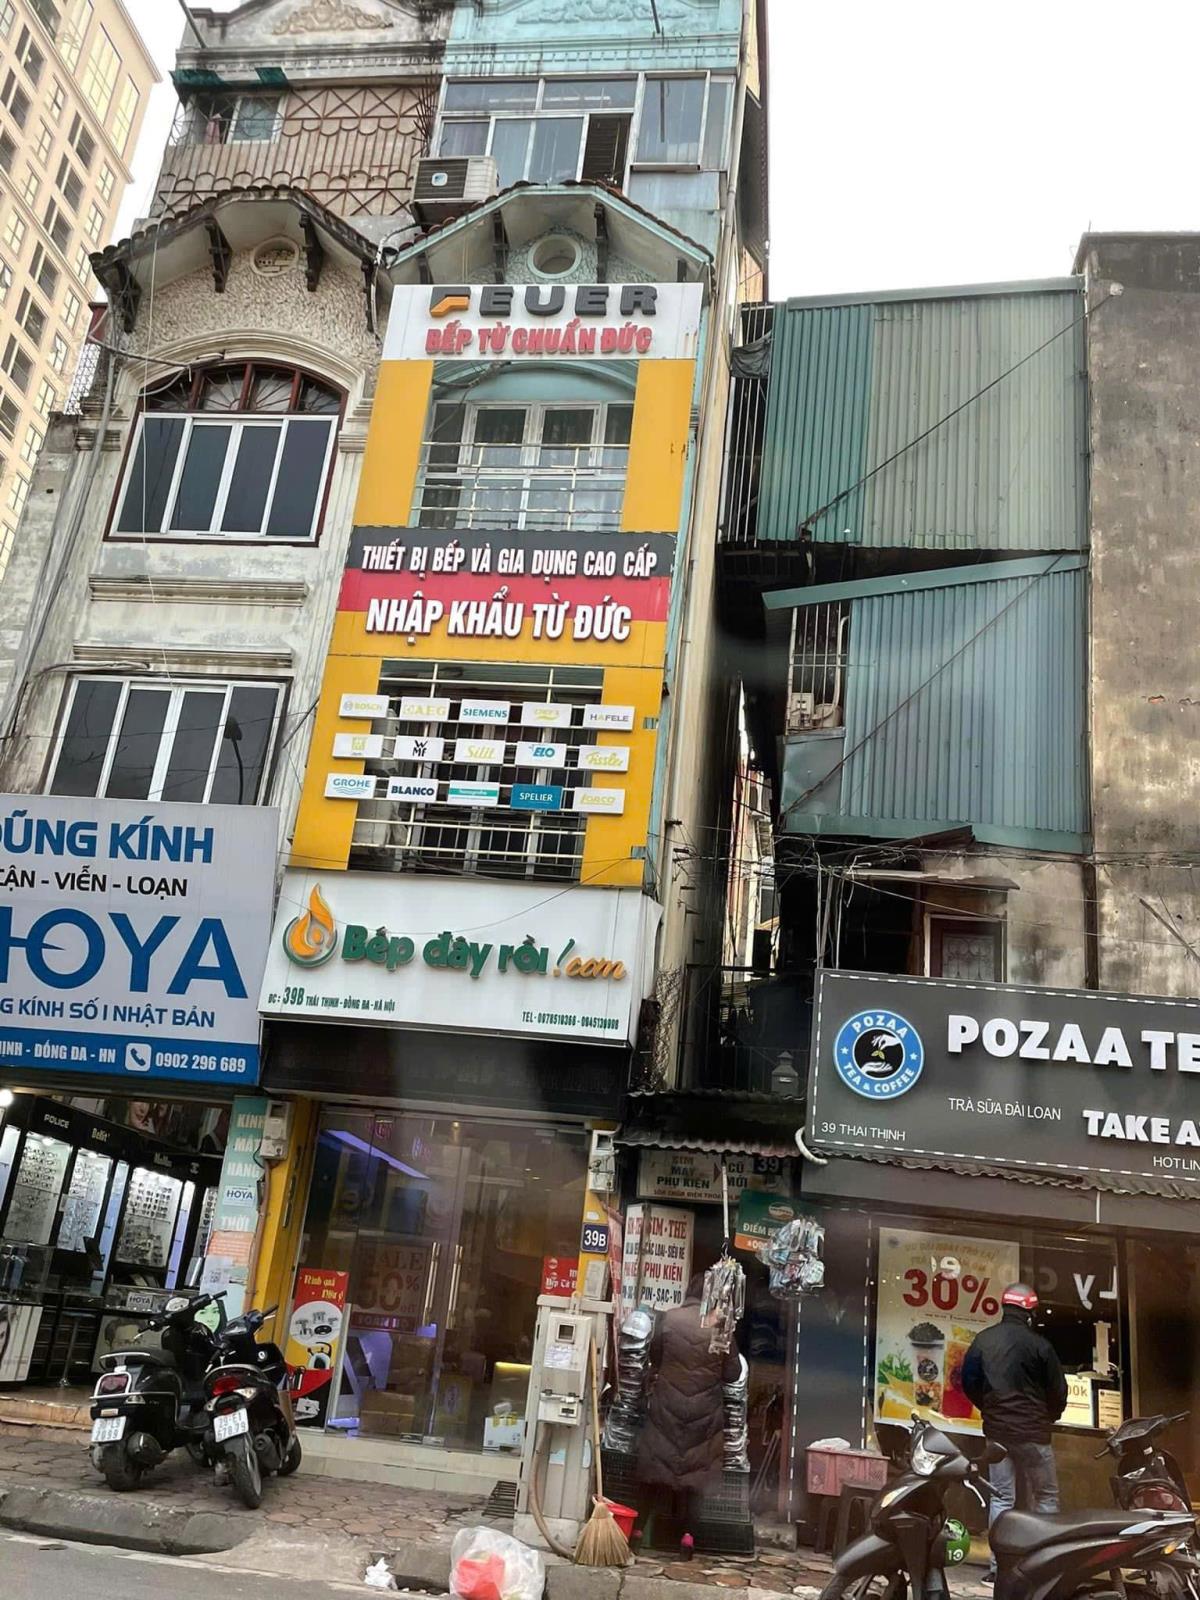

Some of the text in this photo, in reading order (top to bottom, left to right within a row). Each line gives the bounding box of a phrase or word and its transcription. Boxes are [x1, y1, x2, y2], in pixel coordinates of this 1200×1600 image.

[429, 286, 657, 318] FEUER
[425, 316, 653, 355] BẾP TỪ CHUẨN ĐỨC
[362, 537, 658, 584] THIẾT BỊ BẾP VÀ GIA DỤNG CAO CẤP
[366, 585, 632, 645] NHẬP KHẨU TỪ ĐỨC
[462, 707, 508, 719] SIEMENS
[333, 777, 371, 788] GROHE
[391, 785, 435, 797] BLANCO
[519, 791, 553, 802] SPELIER
[0, 810, 214, 864] ŨNG KÍNH
[54, 865, 107, 892] VIỄN
[127, 876, 188, 900] LOẠN
[341, 924, 415, 972] Bếp
[423, 931, 493, 979] đây
[283, 986, 305, 1006] 39B
[18, 995, 65, 1018] KÍNH
[70, 997, 99, 1020] SỐ
[113, 1003, 168, 1028] NHẬT
[172, 1006, 215, 1027] BẢN
[851, 1014, 908, 1039] POZAA
[0, 1040, 23, 1057] ỊNH
[99, 1048, 116, 1063] HN
[948, 1015, 1133, 1068] POZAA
[155, 1052, 246, 1073] 0902 296 689
[843, 1061, 862, 1086] TEA
[874, 1067, 916, 1093] COFFEE
[44, 1113, 70, 1129] POLICE
[949, 1097, 1061, 1121] TRÀ SỮA ĐÀI LOAN
[821, 1121, 906, 1144] 39 THAI THỊNH
[1082, 1110, 1170, 1145] TAKE
[758, 1157, 780, 1173] 39
[226, 1189, 254, 1200] HOYA
[584, 1229, 606, 1248] 39B
[643, 1261, 661, 1282] PHỤ
[663, 1262, 683, 1285] KIỆN
[129, 1295, 151, 1305] HOYA
[903, 1268, 999, 1317] 30%
